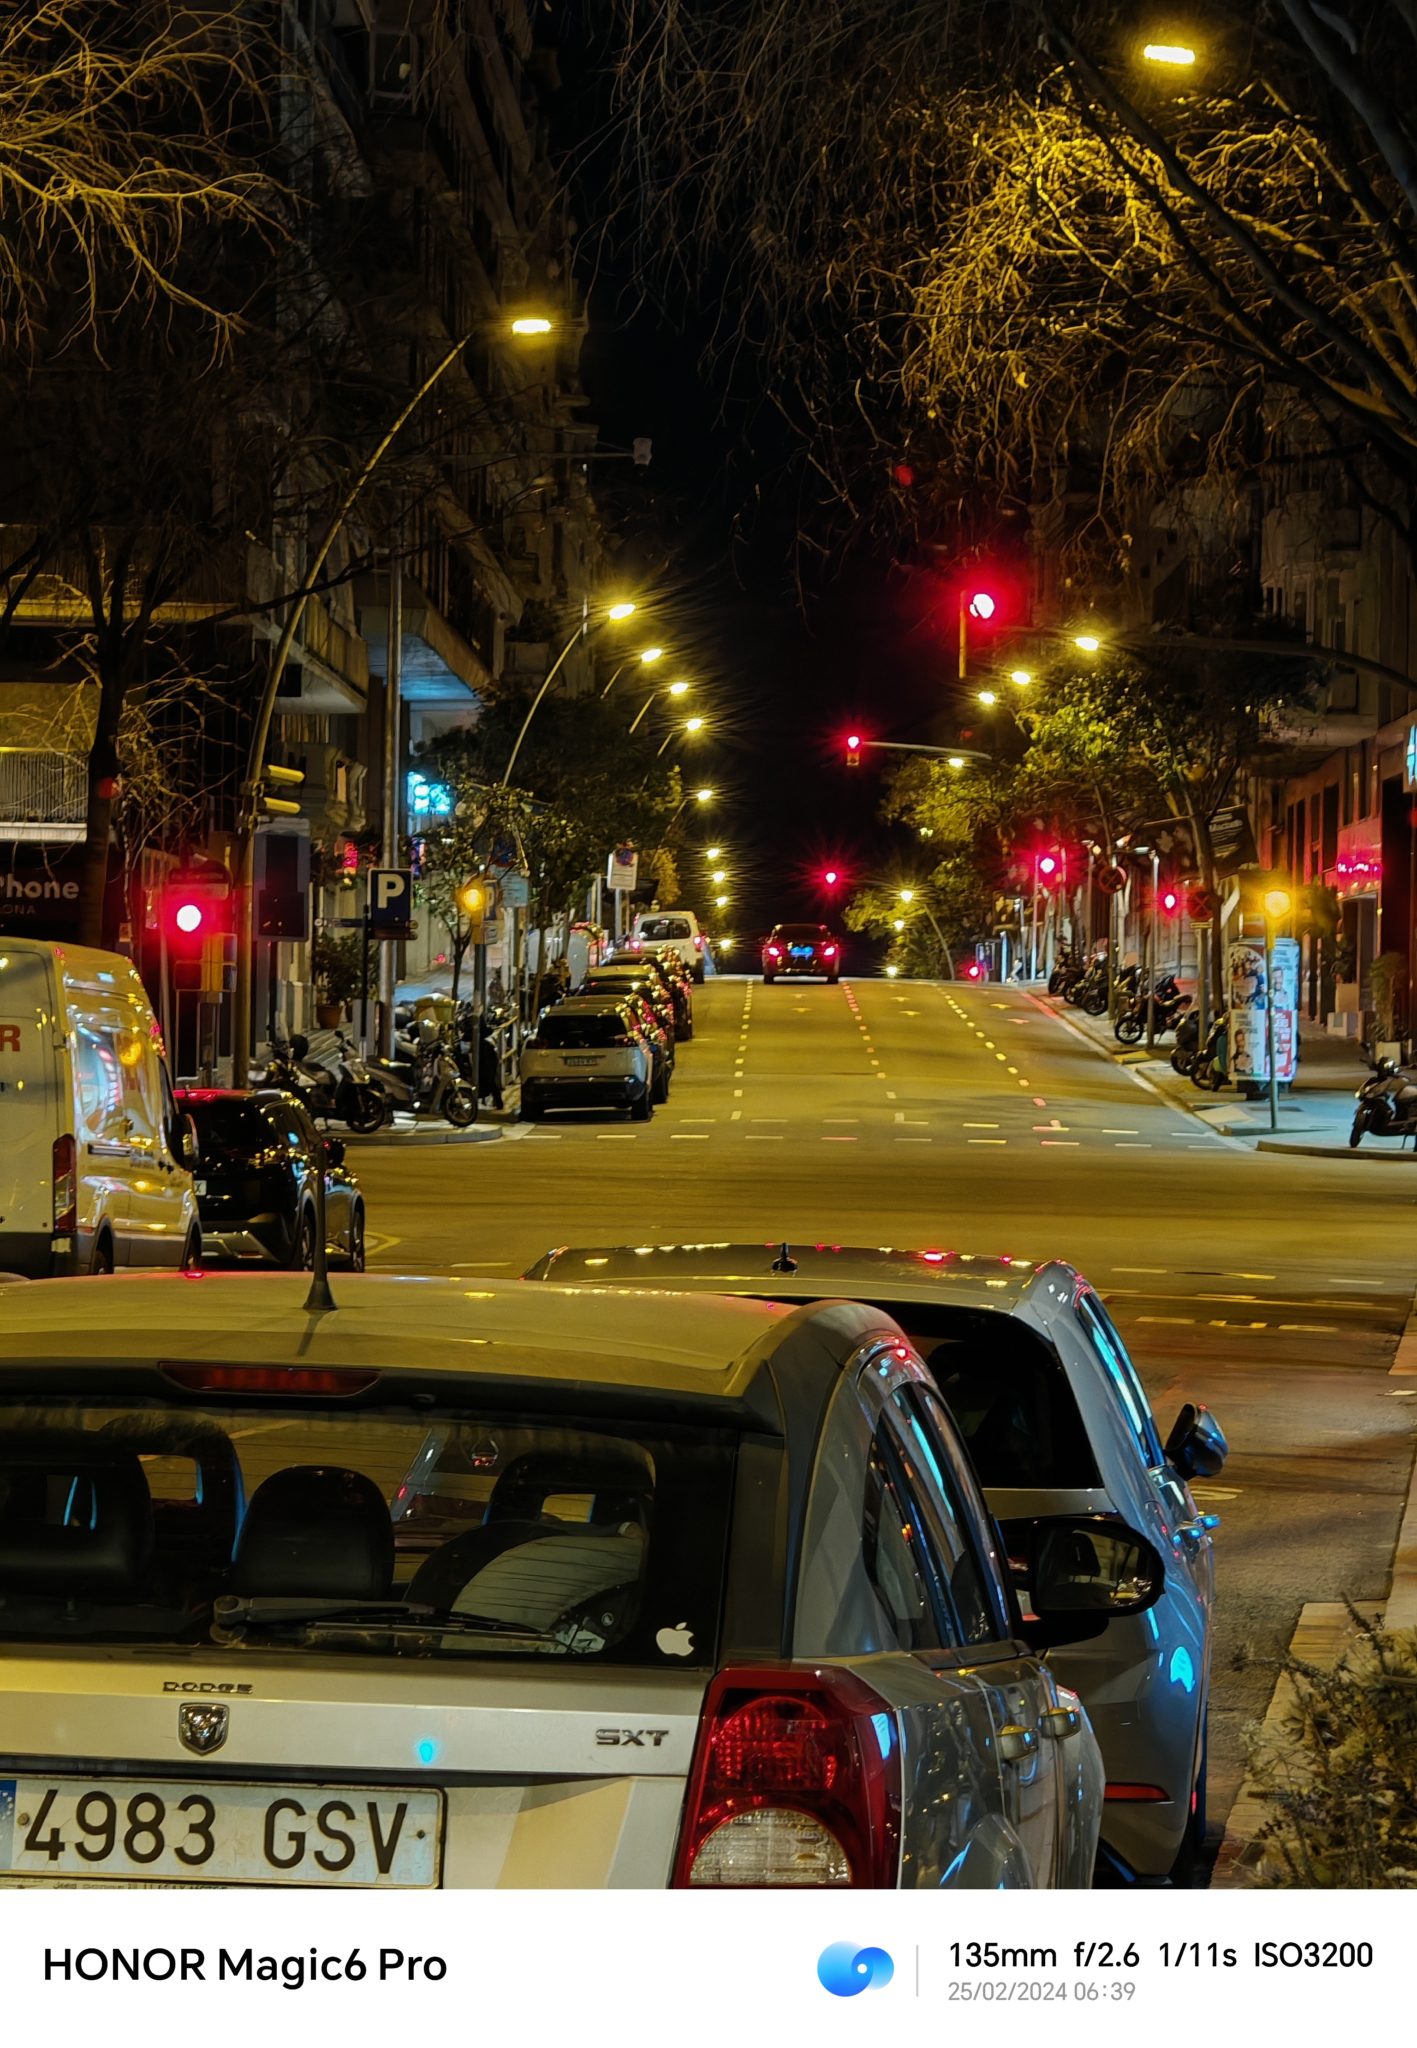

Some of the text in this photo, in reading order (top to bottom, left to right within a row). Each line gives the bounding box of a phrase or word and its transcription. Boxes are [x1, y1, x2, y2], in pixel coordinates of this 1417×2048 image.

[378, 873, 405, 909] P
[163, 1682, 253, 1694] DODGE
[596, 1729, 669, 1746] SXT
[24, 1789, 408, 1875] 4983 GSV
